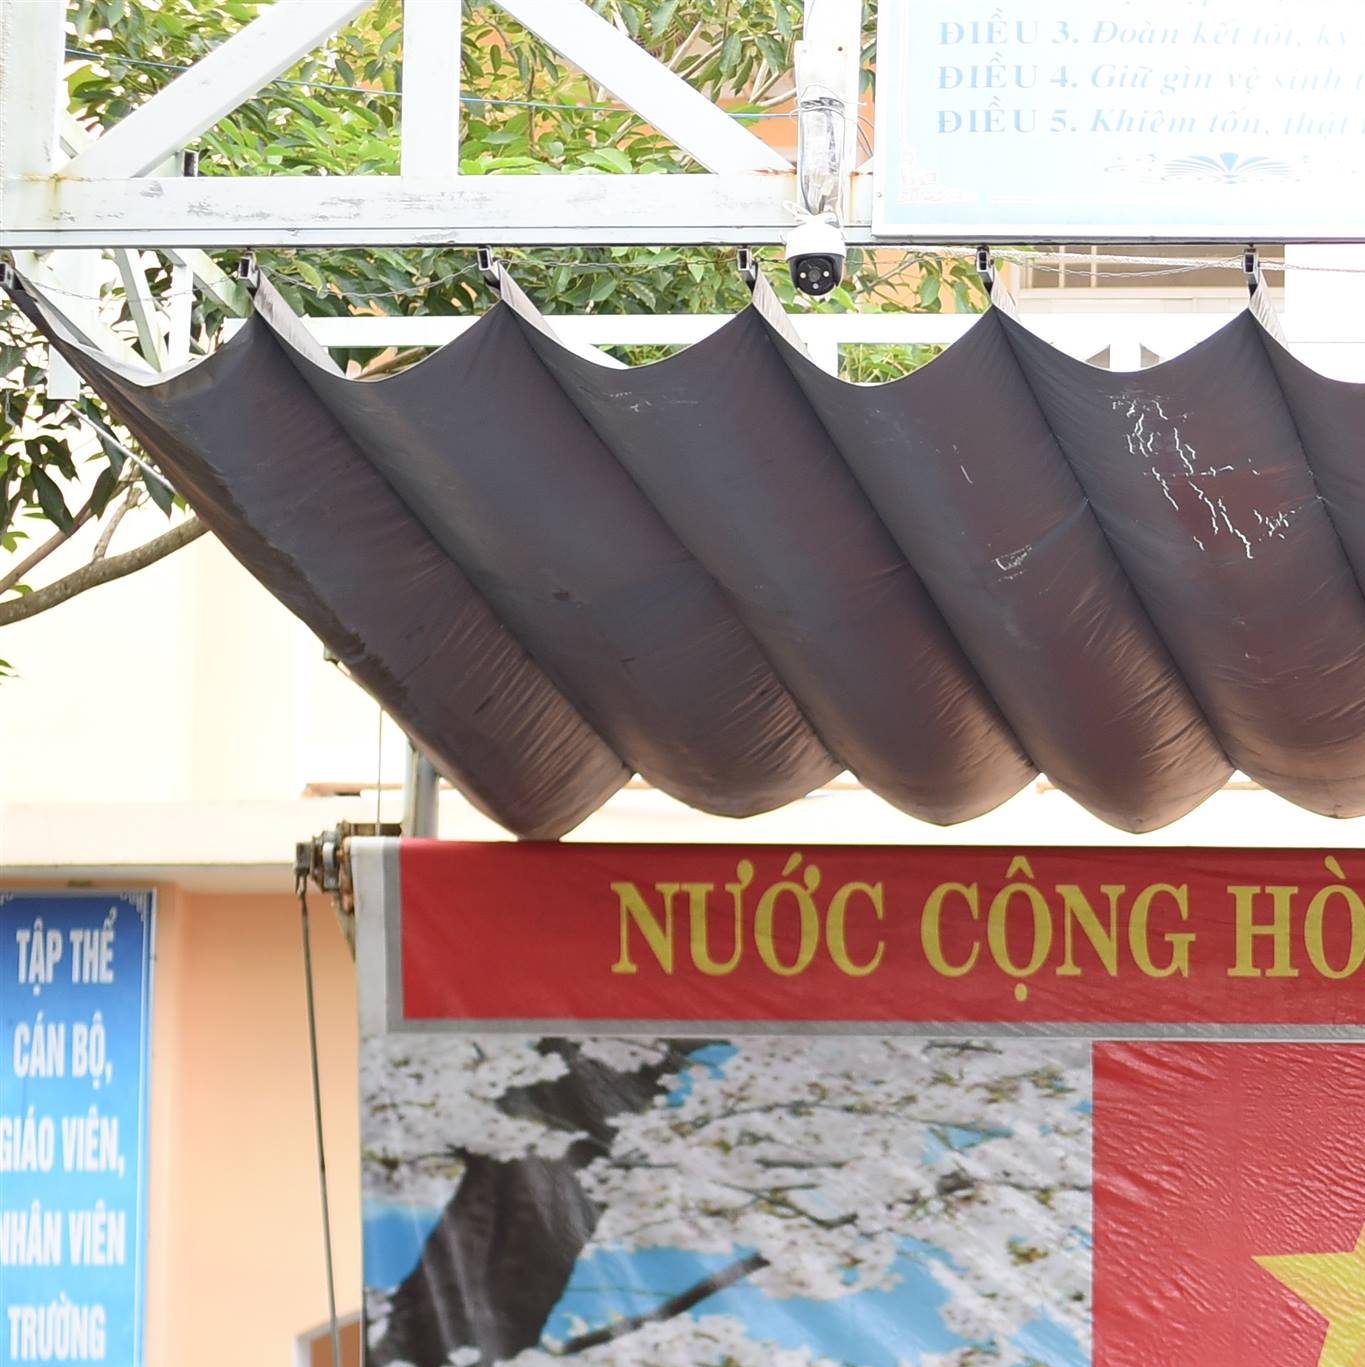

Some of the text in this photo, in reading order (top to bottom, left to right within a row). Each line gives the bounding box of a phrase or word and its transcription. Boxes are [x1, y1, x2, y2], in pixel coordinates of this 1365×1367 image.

[938, 8, 1040, 45] ĐIỀU
[1050, 20, 1079, 45] 3.
[1091, 18, 1180, 45] Đoàn
[936, 52, 1038, 89] ĐIỀU
[1050, 65, 1077, 89] 4.
[1090, 64, 1155, 89] Giữ
[936, 96, 1038, 133] ĐIỀU
[1050, 109, 1077, 133] 5.
[1090, 108, 1197, 133] Khiêm
[16, 906, 118, 996] TẬP THỂ
[613, 854, 884, 977] NƯỚC
[922, 857, 1195, 1002] CỘNG
[13, 1010, 113, 1090] CÁN BỘ,
[0, 1104, 125, 1179] GIÁO VIÊN,
[68, 1198, 125, 1266] VIÊN
[8, 1290, 106, 1360] TRƯỜNG
